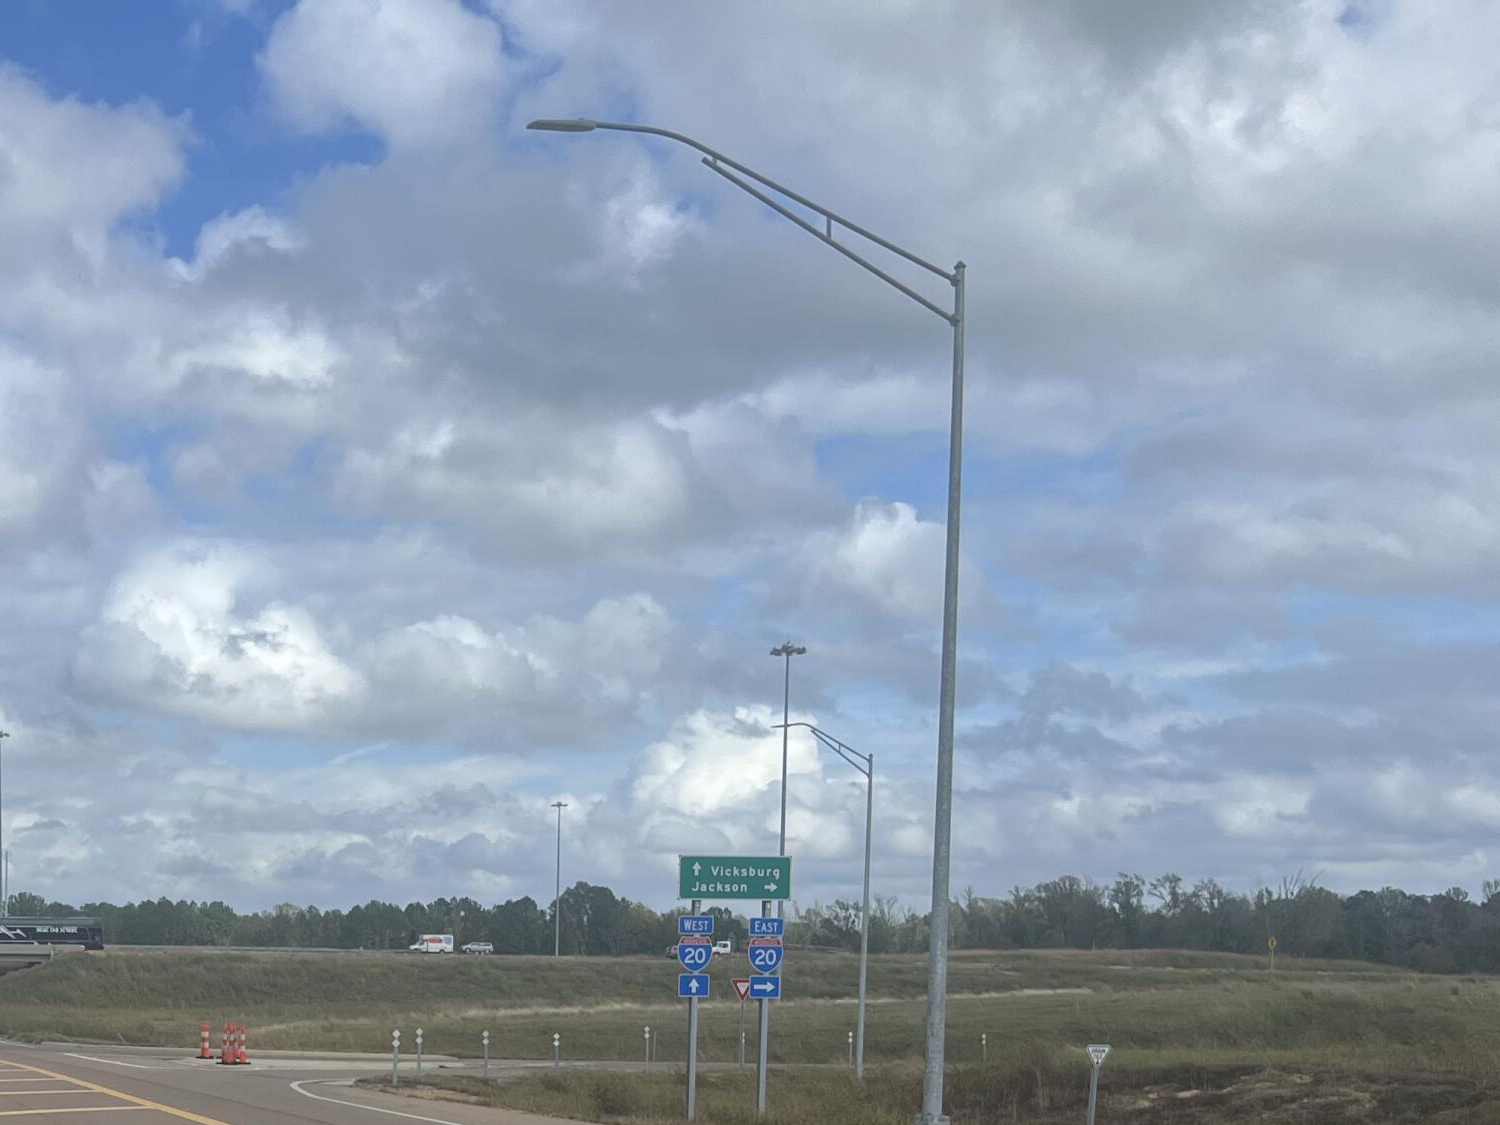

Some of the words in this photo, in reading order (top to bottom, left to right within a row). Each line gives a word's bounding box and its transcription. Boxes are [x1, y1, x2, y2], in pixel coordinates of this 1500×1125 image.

[711, 866, 780, 880] Vicksburg
[692, 881, 747, 892] Jackson
[684, 919, 708, 931] WEST
[754, 920, 778, 933] EAST
[684, 947, 706, 964] 20
[755, 949, 777, 965] 20
